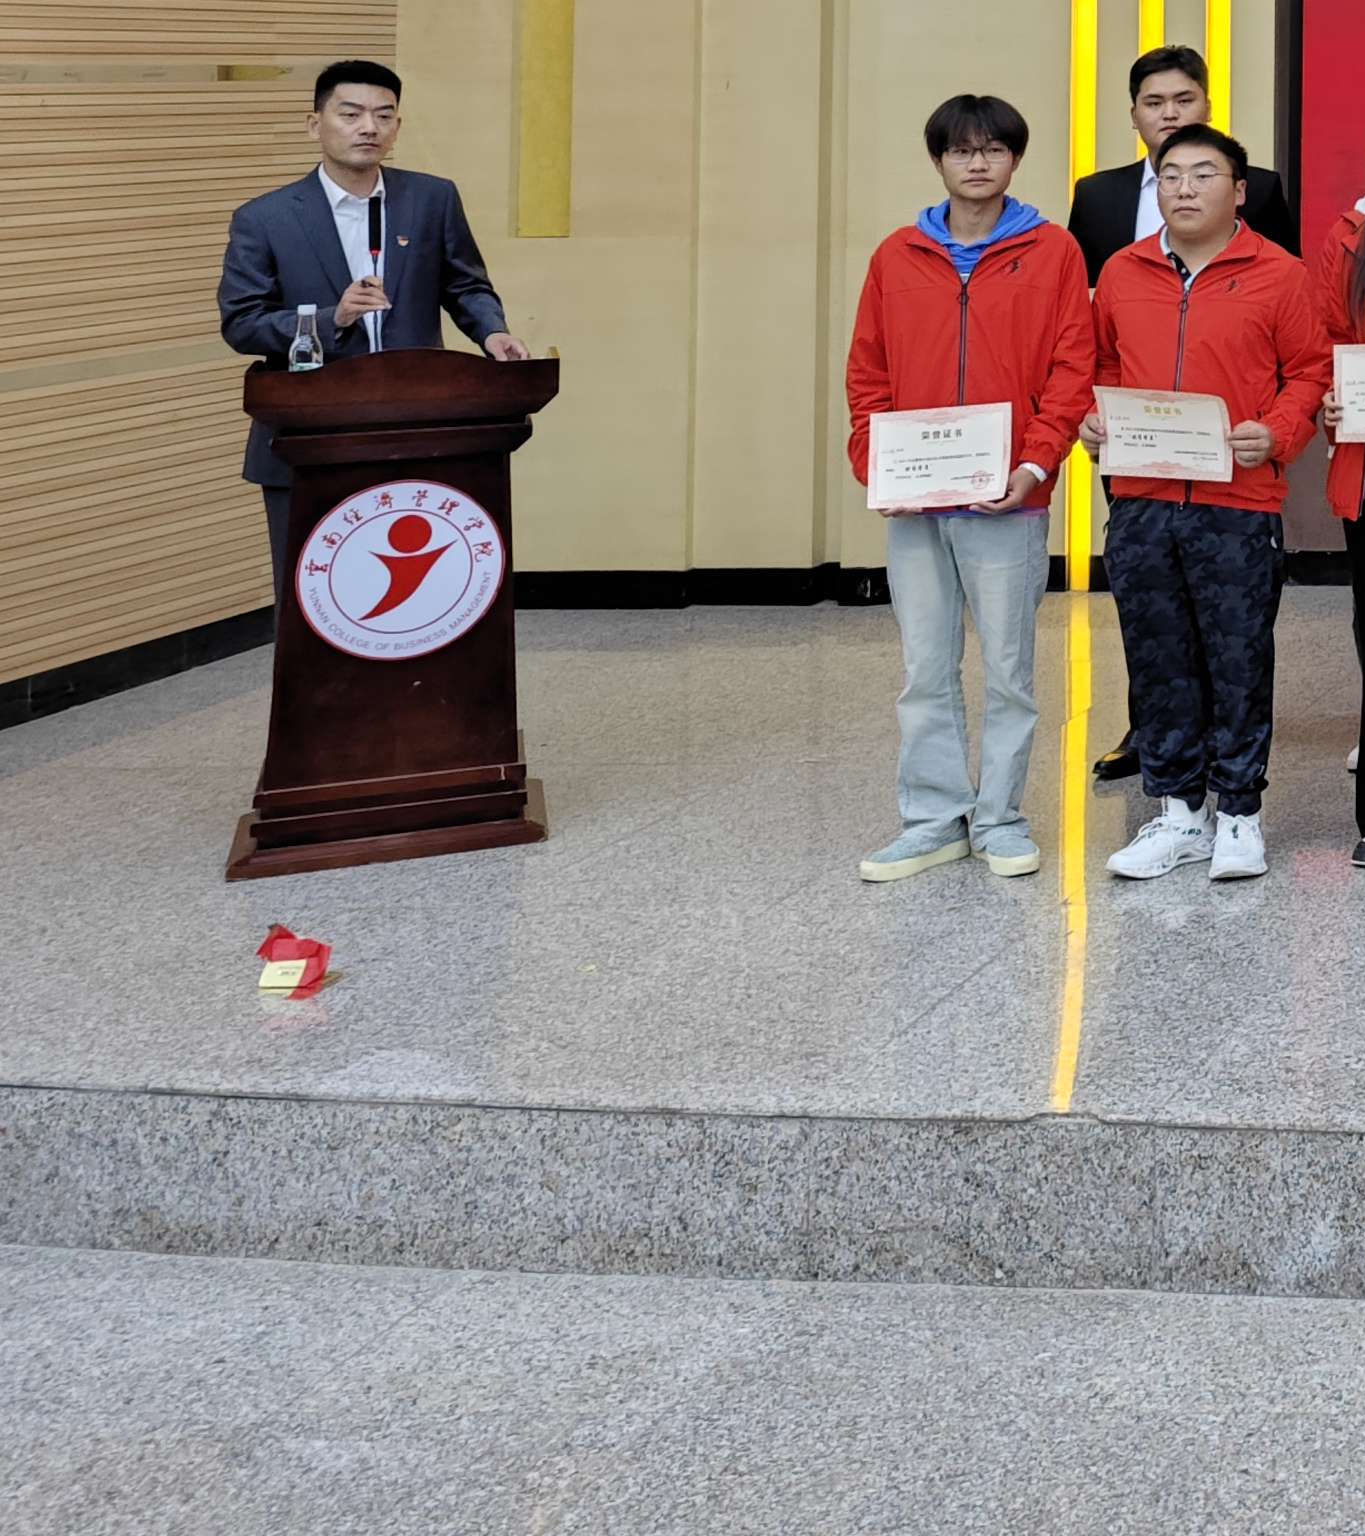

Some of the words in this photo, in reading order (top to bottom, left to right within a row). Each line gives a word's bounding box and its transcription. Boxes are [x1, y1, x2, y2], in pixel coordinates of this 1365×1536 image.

[309, 587, 330, 624] YUNNAN
[328, 623, 371, 649] COLLEGE
[374, 642, 390, 651] OF
[393, 628, 448, 651] BUSINESS
[448, 571, 492, 630] MANAGEMENT
